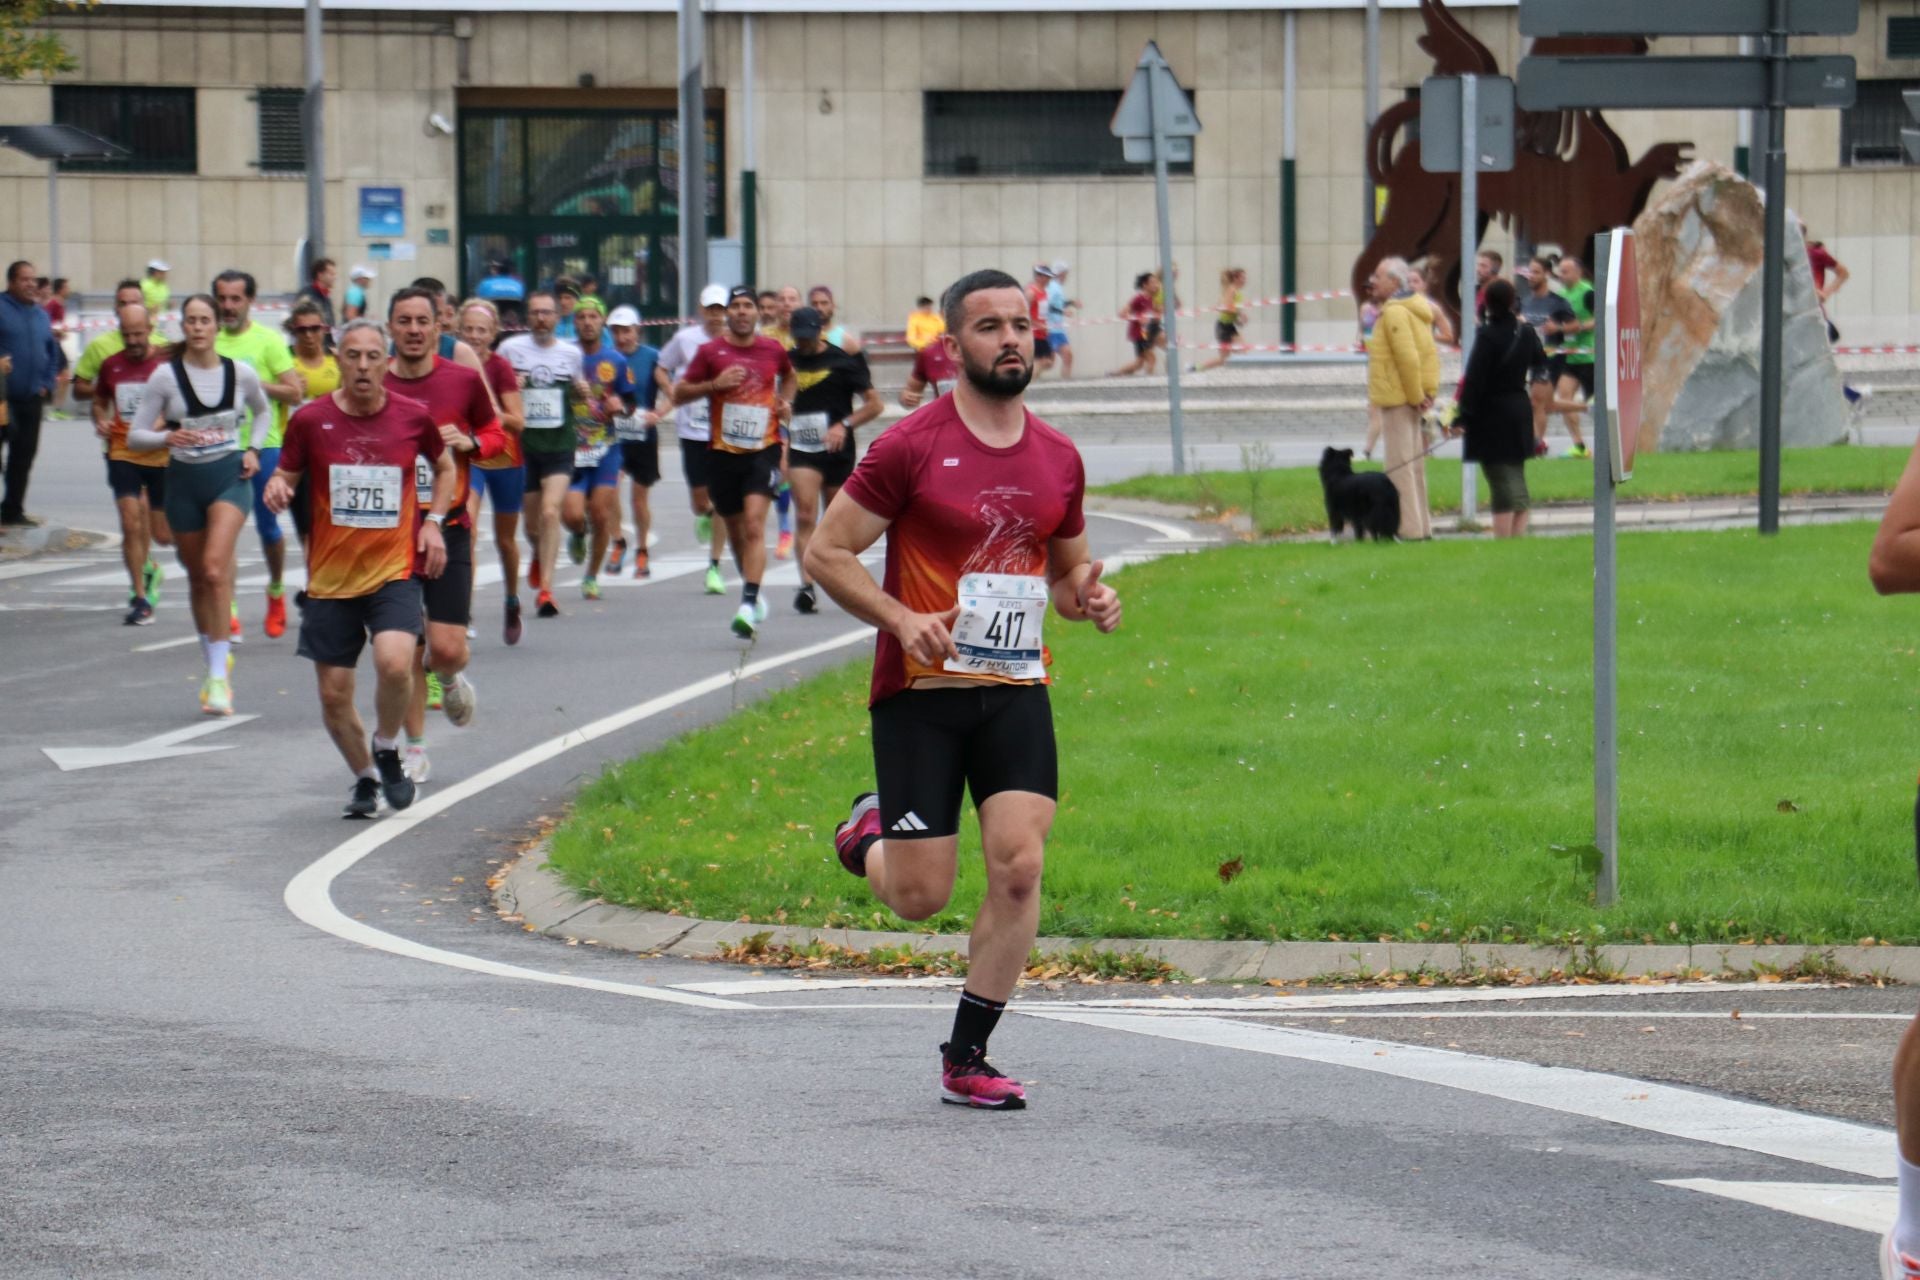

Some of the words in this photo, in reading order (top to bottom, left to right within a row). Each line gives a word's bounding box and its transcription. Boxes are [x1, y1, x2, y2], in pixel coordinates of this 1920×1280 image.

[1620, 328, 1641, 381] STOP
[733, 419, 757, 437] 507
[347, 487, 384, 510] 376
[998, 599, 1023, 610] ALEXIS
[984, 610, 1026, 649] 417
[987, 660, 1028, 673] HYUNDAI
